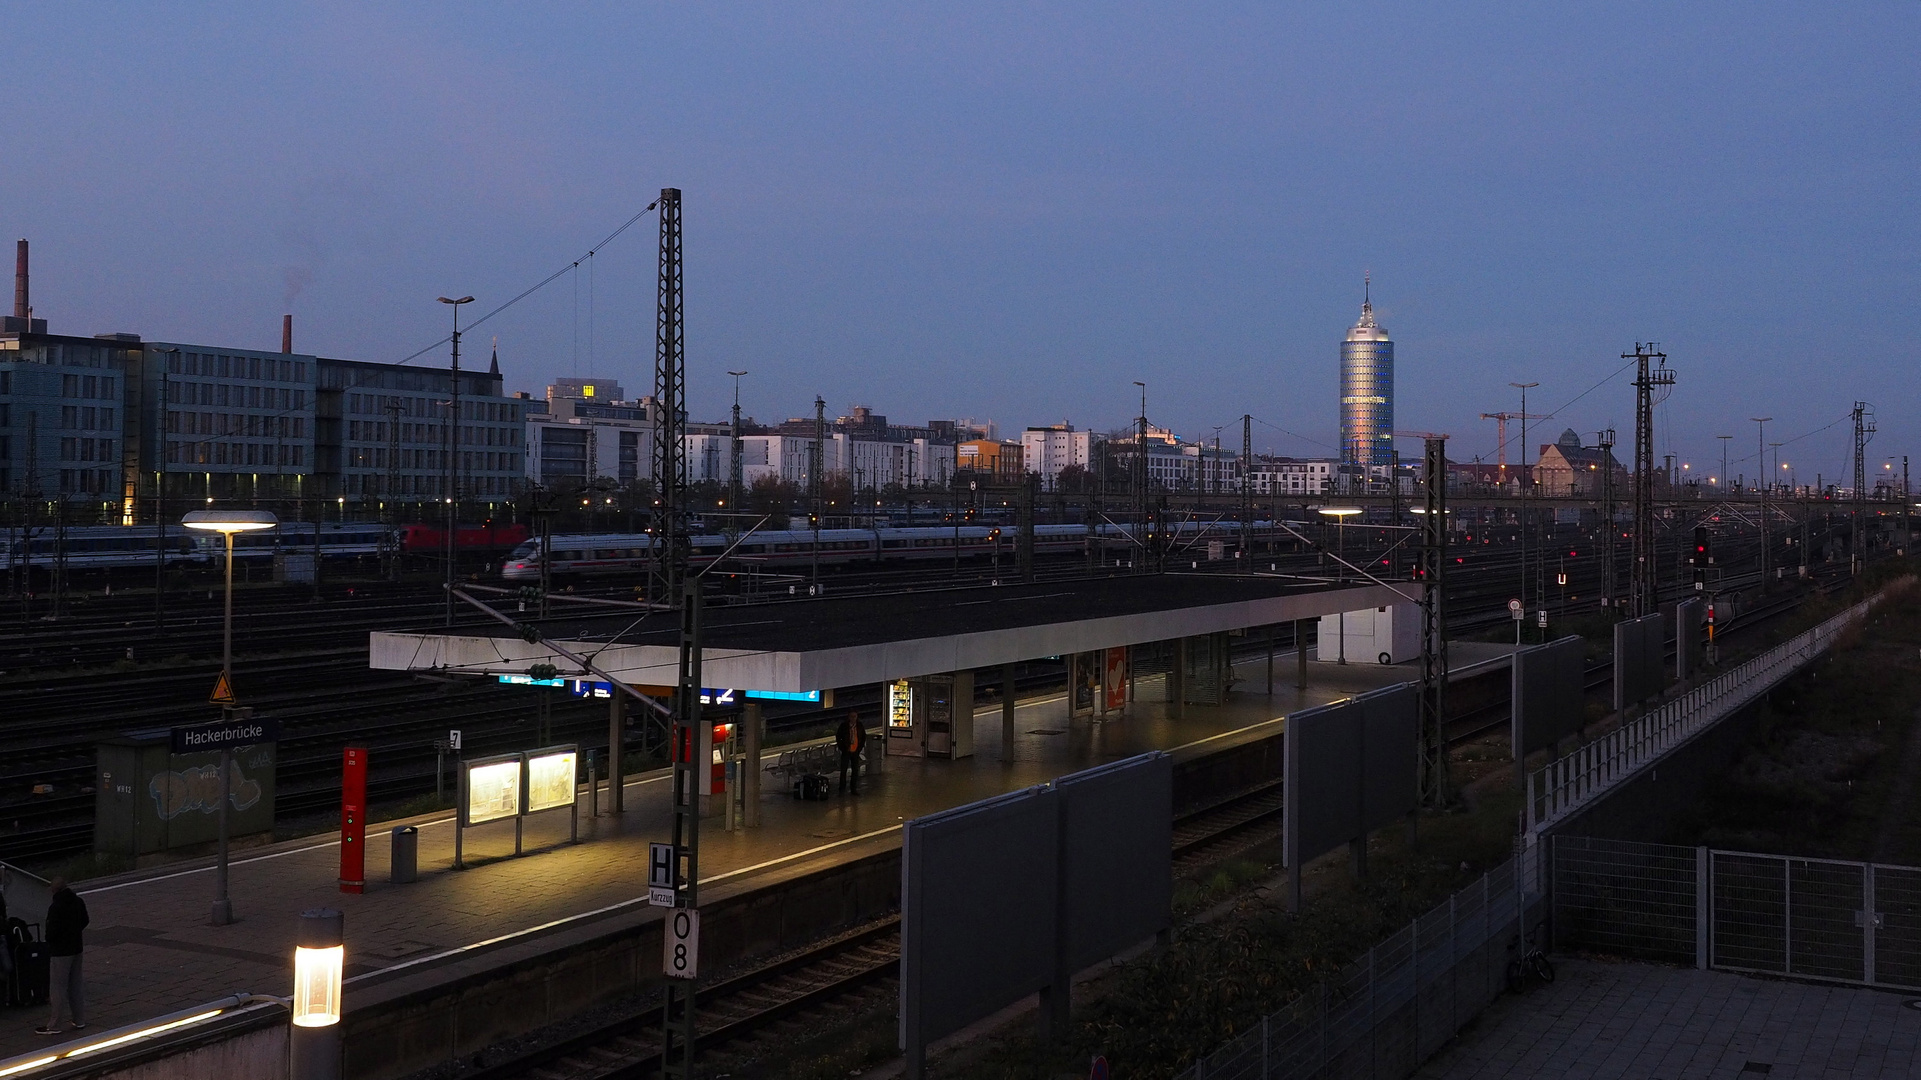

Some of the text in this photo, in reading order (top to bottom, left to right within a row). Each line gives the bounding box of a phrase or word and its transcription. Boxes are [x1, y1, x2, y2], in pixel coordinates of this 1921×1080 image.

[185, 724, 263, 746] Hackerbrücke
[453, 732, 458, 746] 7
[652, 847, 671, 884] H
[650, 890, 674, 906] Kurzzug
[674, 912, 690, 939] 0
[673, 943, 687, 971] 8
